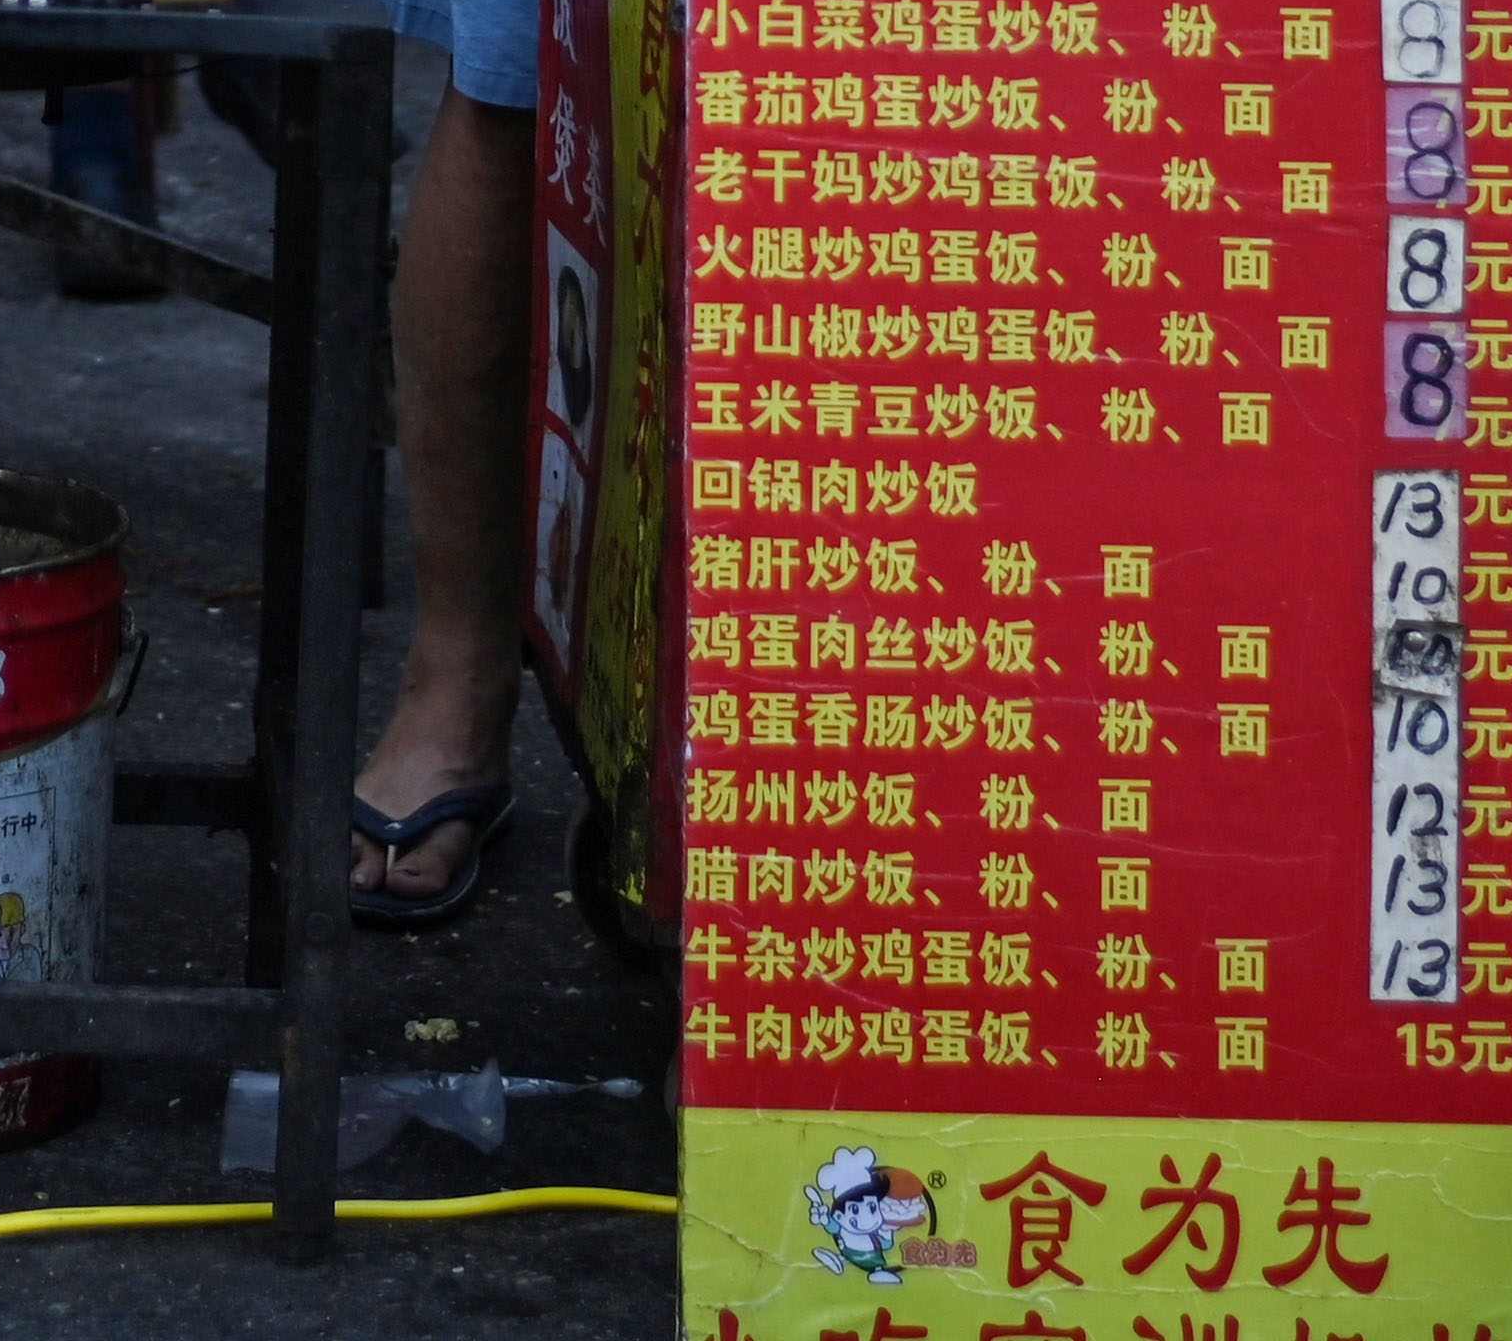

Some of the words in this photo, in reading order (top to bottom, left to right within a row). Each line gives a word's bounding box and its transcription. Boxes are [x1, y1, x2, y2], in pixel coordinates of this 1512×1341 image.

[692, 459, 979, 516] 回锅肉炒饭
[979, 1149, 1391, 1294] 食为先
